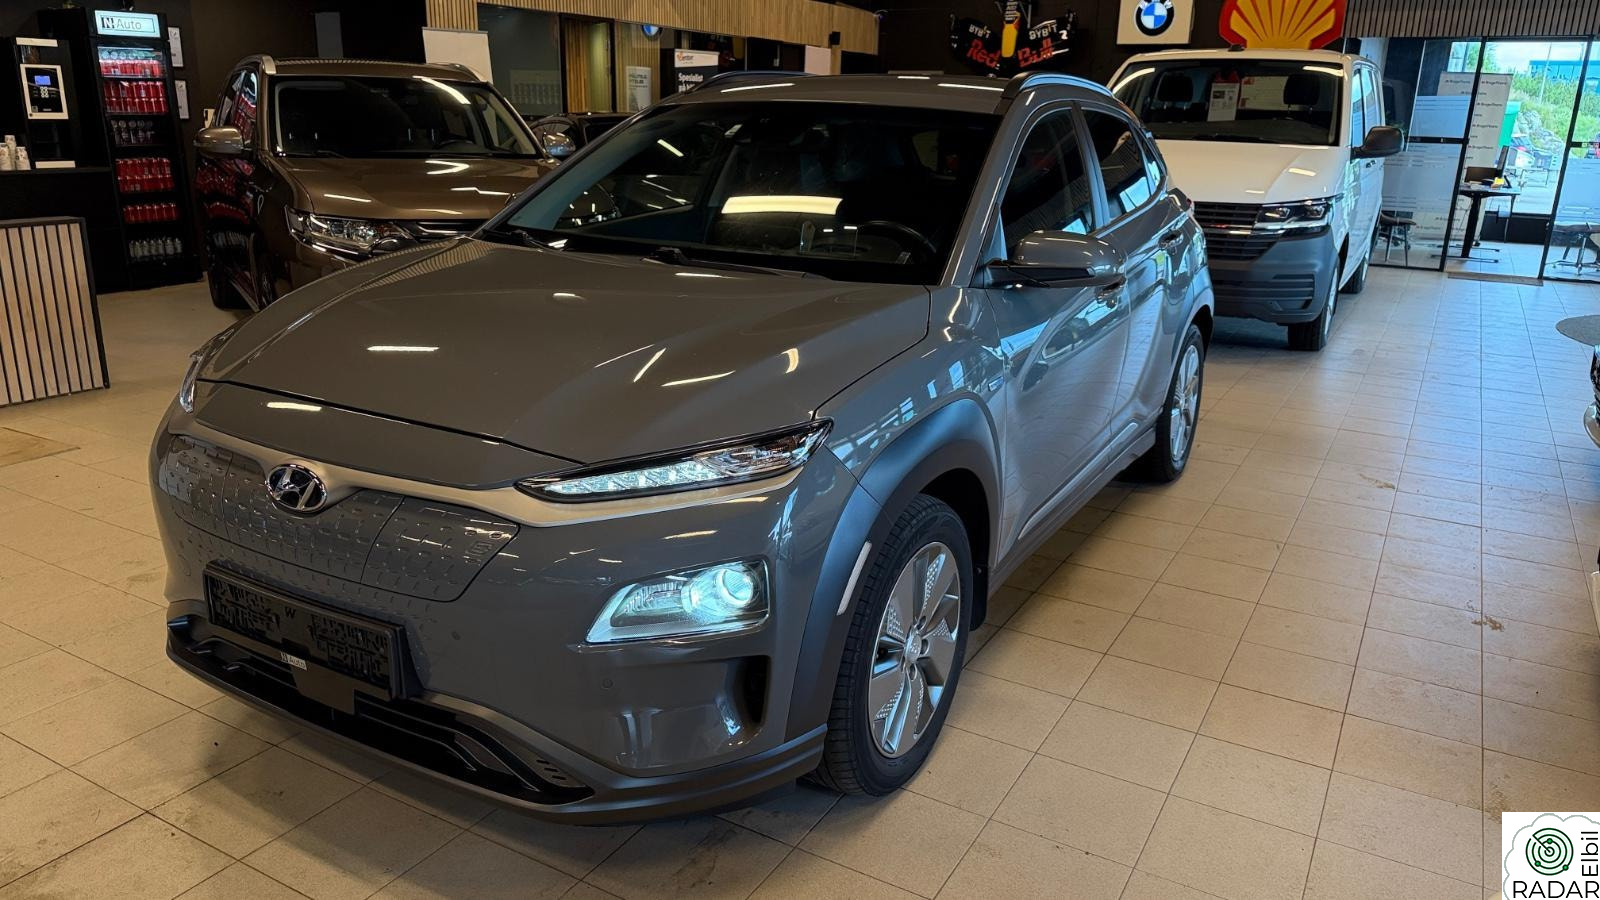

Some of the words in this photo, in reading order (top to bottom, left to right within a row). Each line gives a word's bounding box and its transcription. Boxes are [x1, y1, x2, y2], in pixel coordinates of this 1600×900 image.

[117, 18, 142, 30] Auto
[1028, 23, 1058, 40] BYBIT
[966, 38, 1002, 68] Red
[1018, 37, 1053, 68] Bull
[289, 656, 306, 668] Auto
